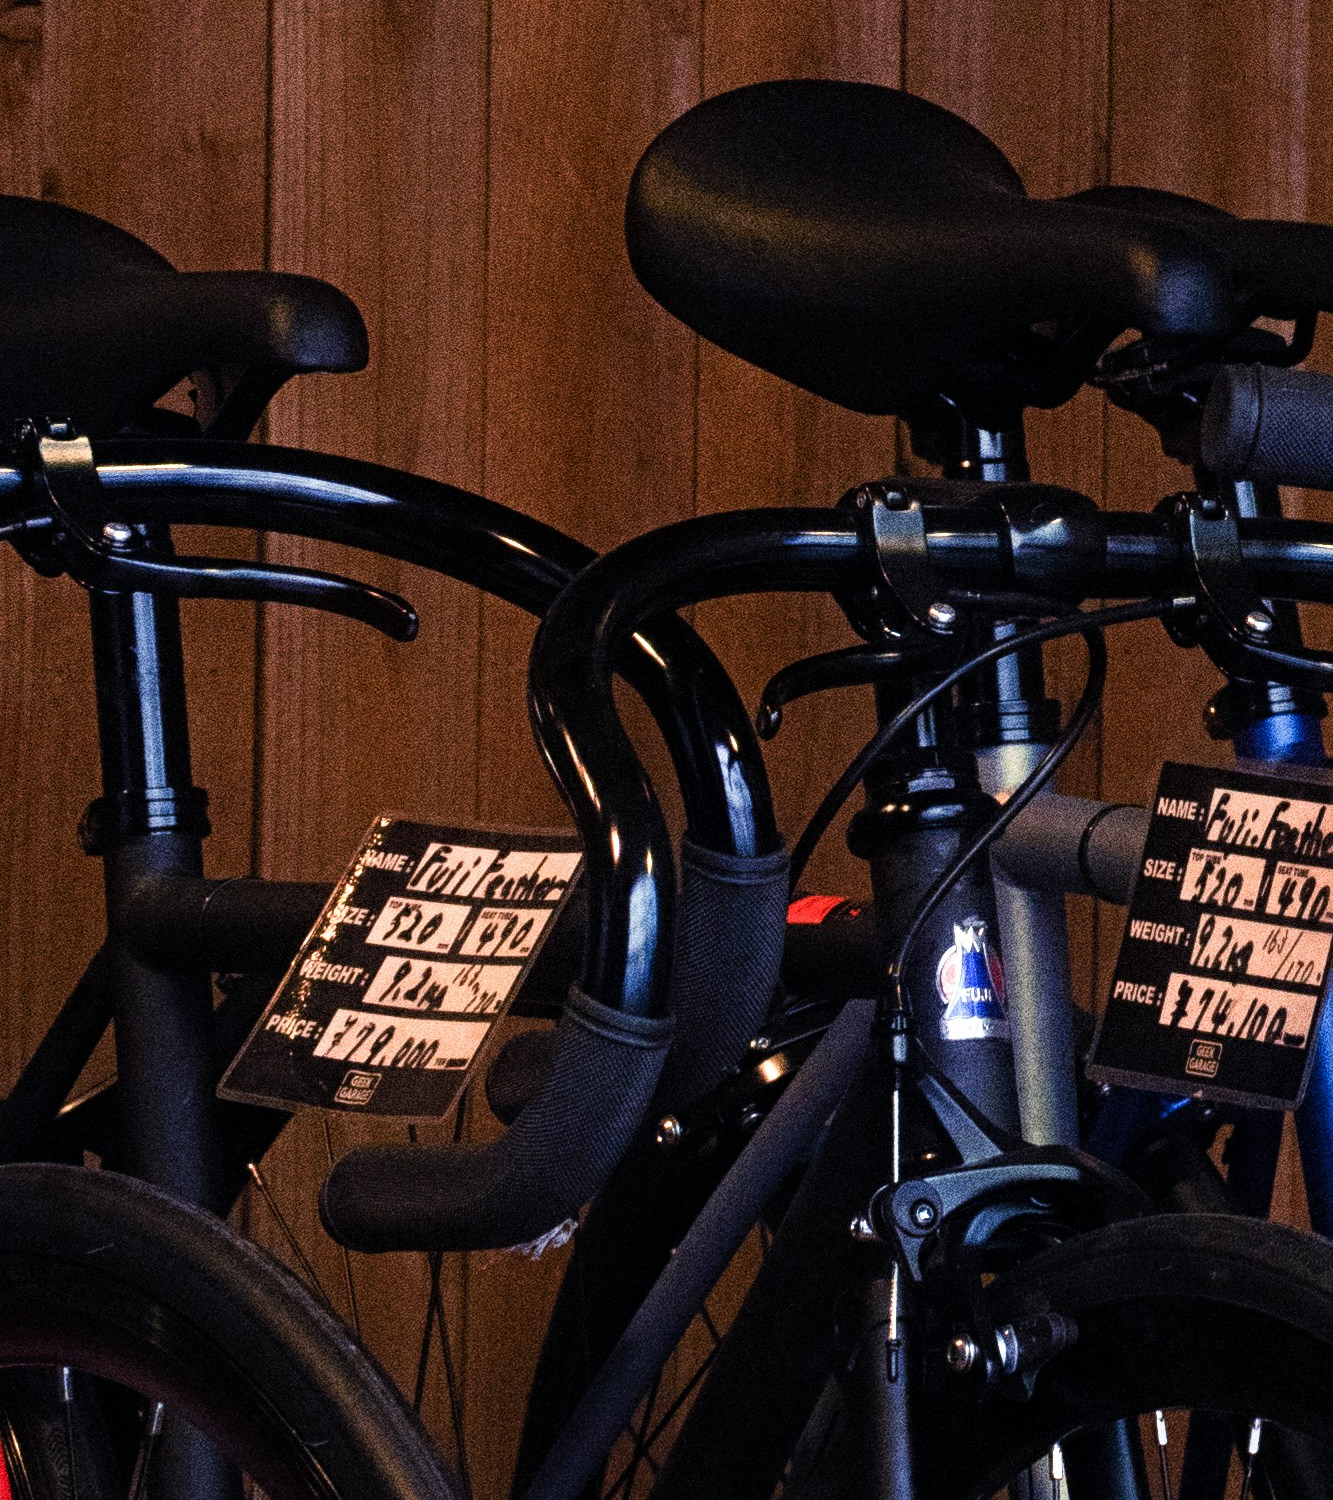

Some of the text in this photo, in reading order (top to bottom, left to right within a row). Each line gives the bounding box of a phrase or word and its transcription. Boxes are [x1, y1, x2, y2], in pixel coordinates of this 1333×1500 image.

[1278, 876, 1331, 921] 490
[382, 904, 443, 945] 520
[476, 915, 534, 957] 490
[962, 986, 992, 1003] FUJI
